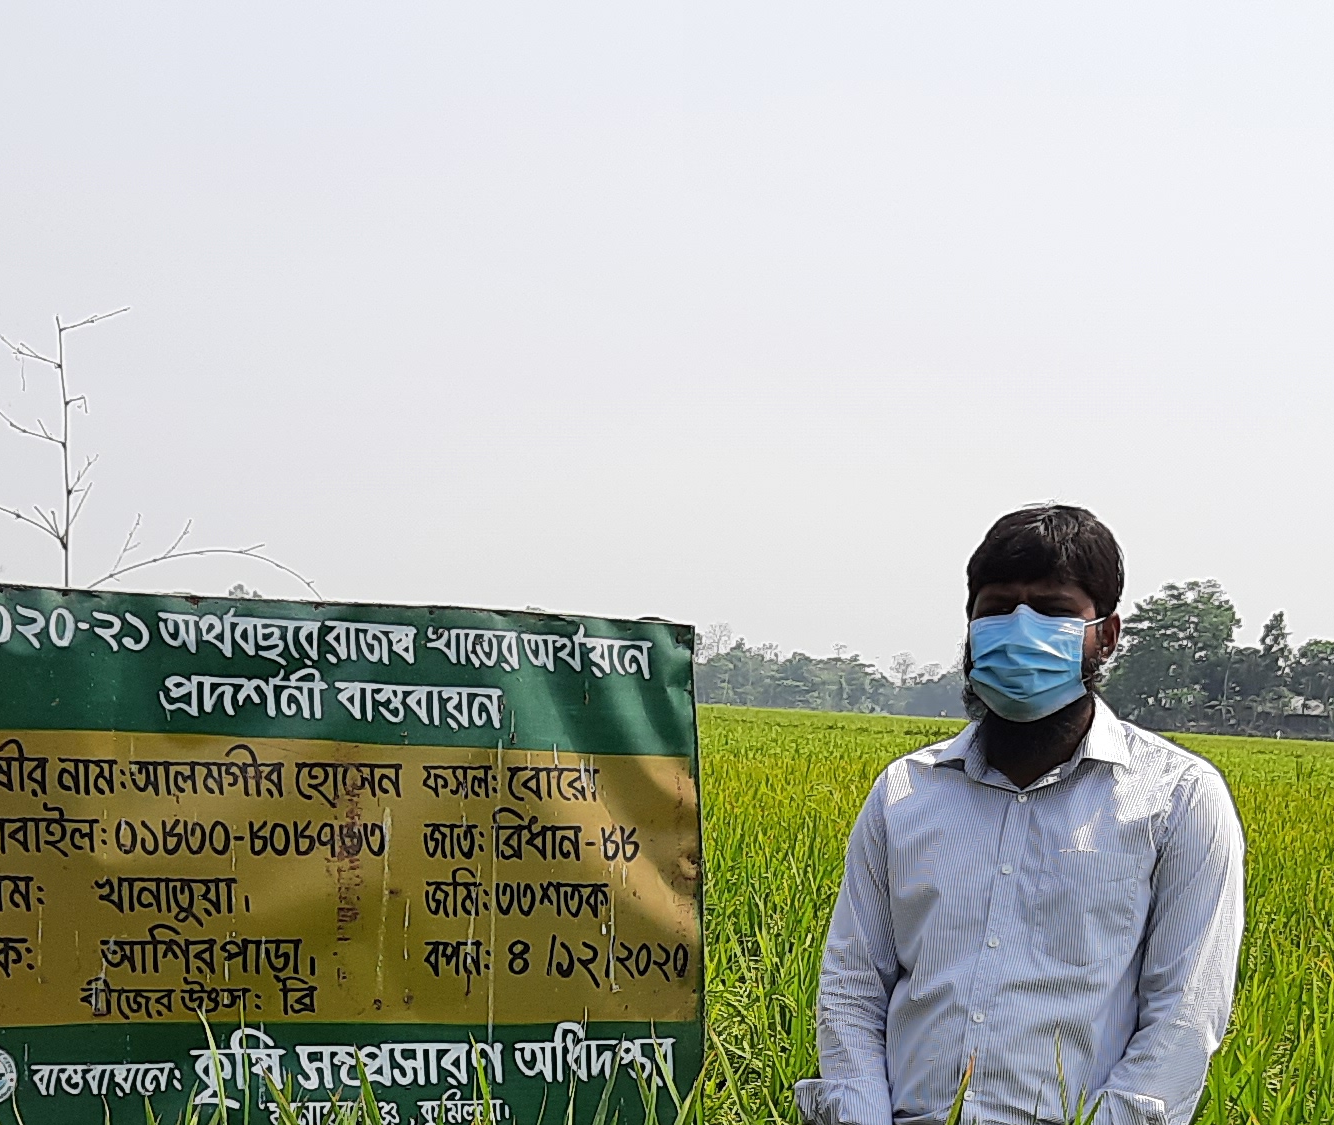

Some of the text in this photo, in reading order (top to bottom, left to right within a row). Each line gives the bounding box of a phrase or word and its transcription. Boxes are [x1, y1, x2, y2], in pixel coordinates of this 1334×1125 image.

[160, 668, 503, 731] প্রদর্শনী বাস্তবায়ন
[295, 761, 403, 808] হোসেন
[190, 1027, 287, 1110] কৃষি
